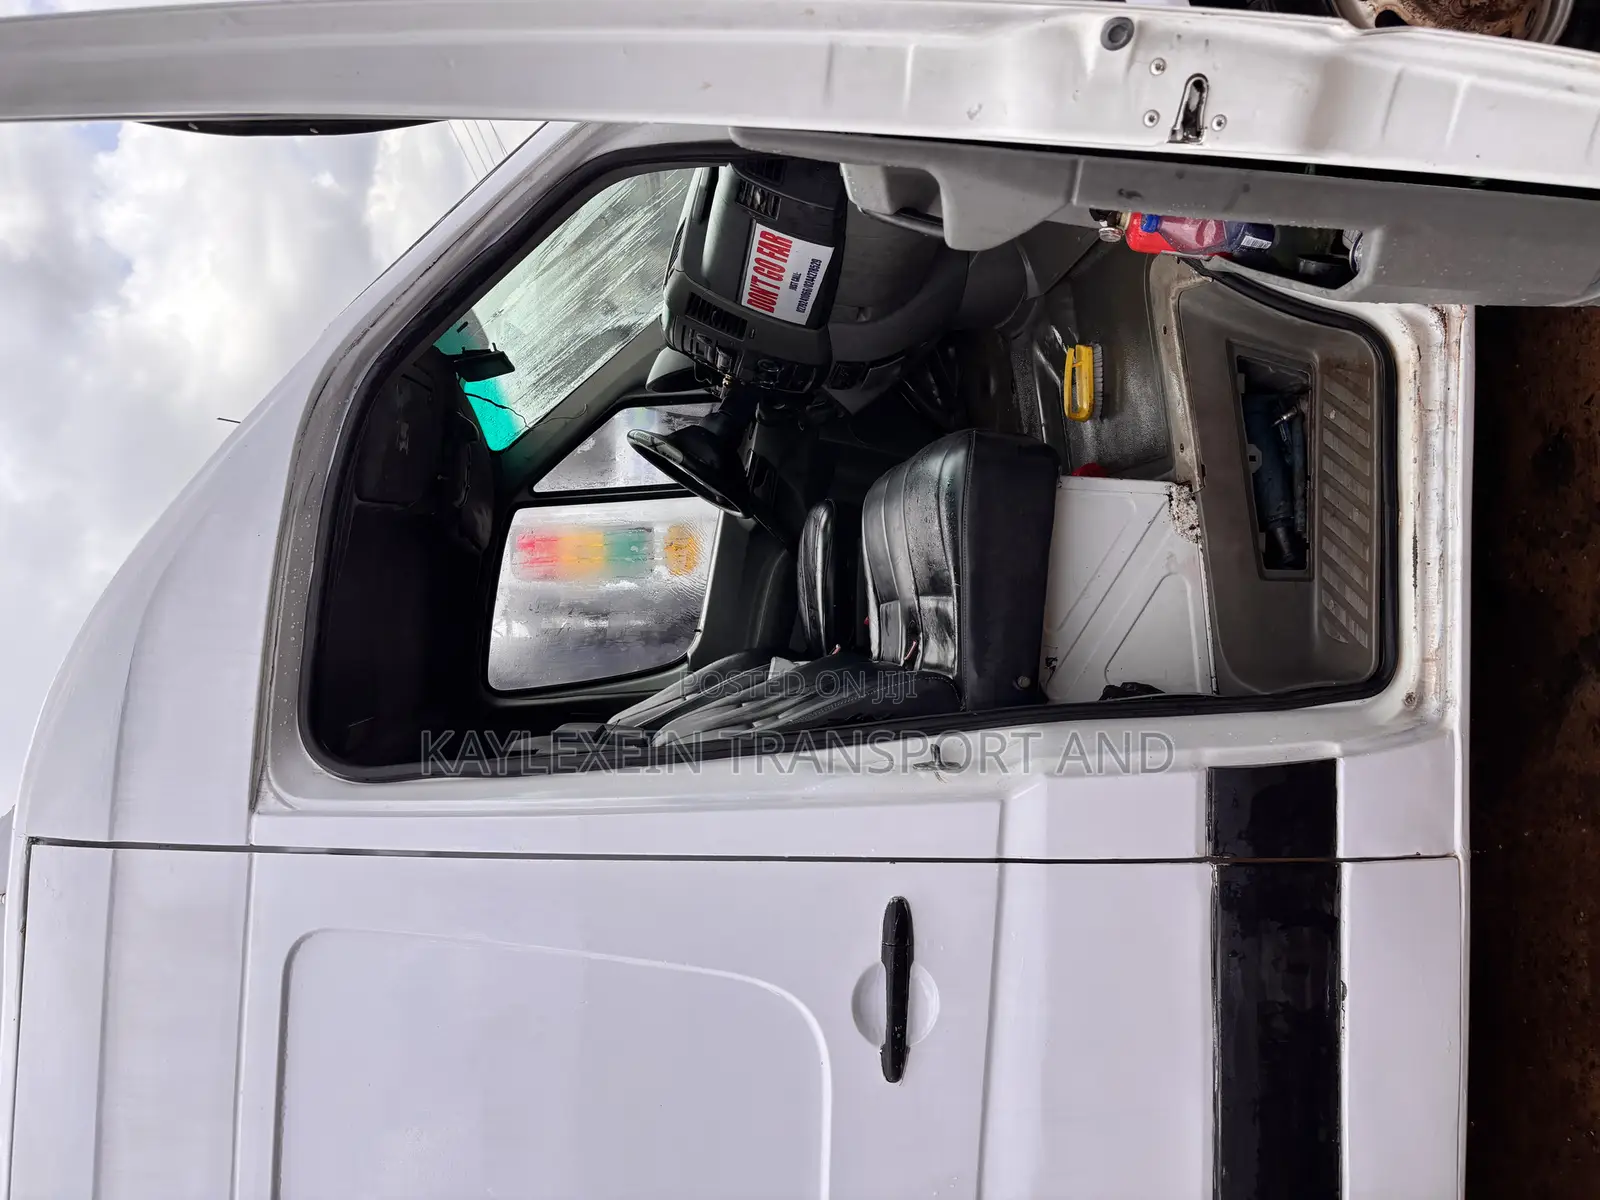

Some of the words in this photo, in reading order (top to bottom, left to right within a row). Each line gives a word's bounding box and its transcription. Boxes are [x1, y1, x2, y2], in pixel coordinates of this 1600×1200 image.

[757, 230, 793, 263] FAR
[753, 257, 786, 282] GO
[746, 275, 780, 313] DON'T
[788, 280, 799, 291] JUST
